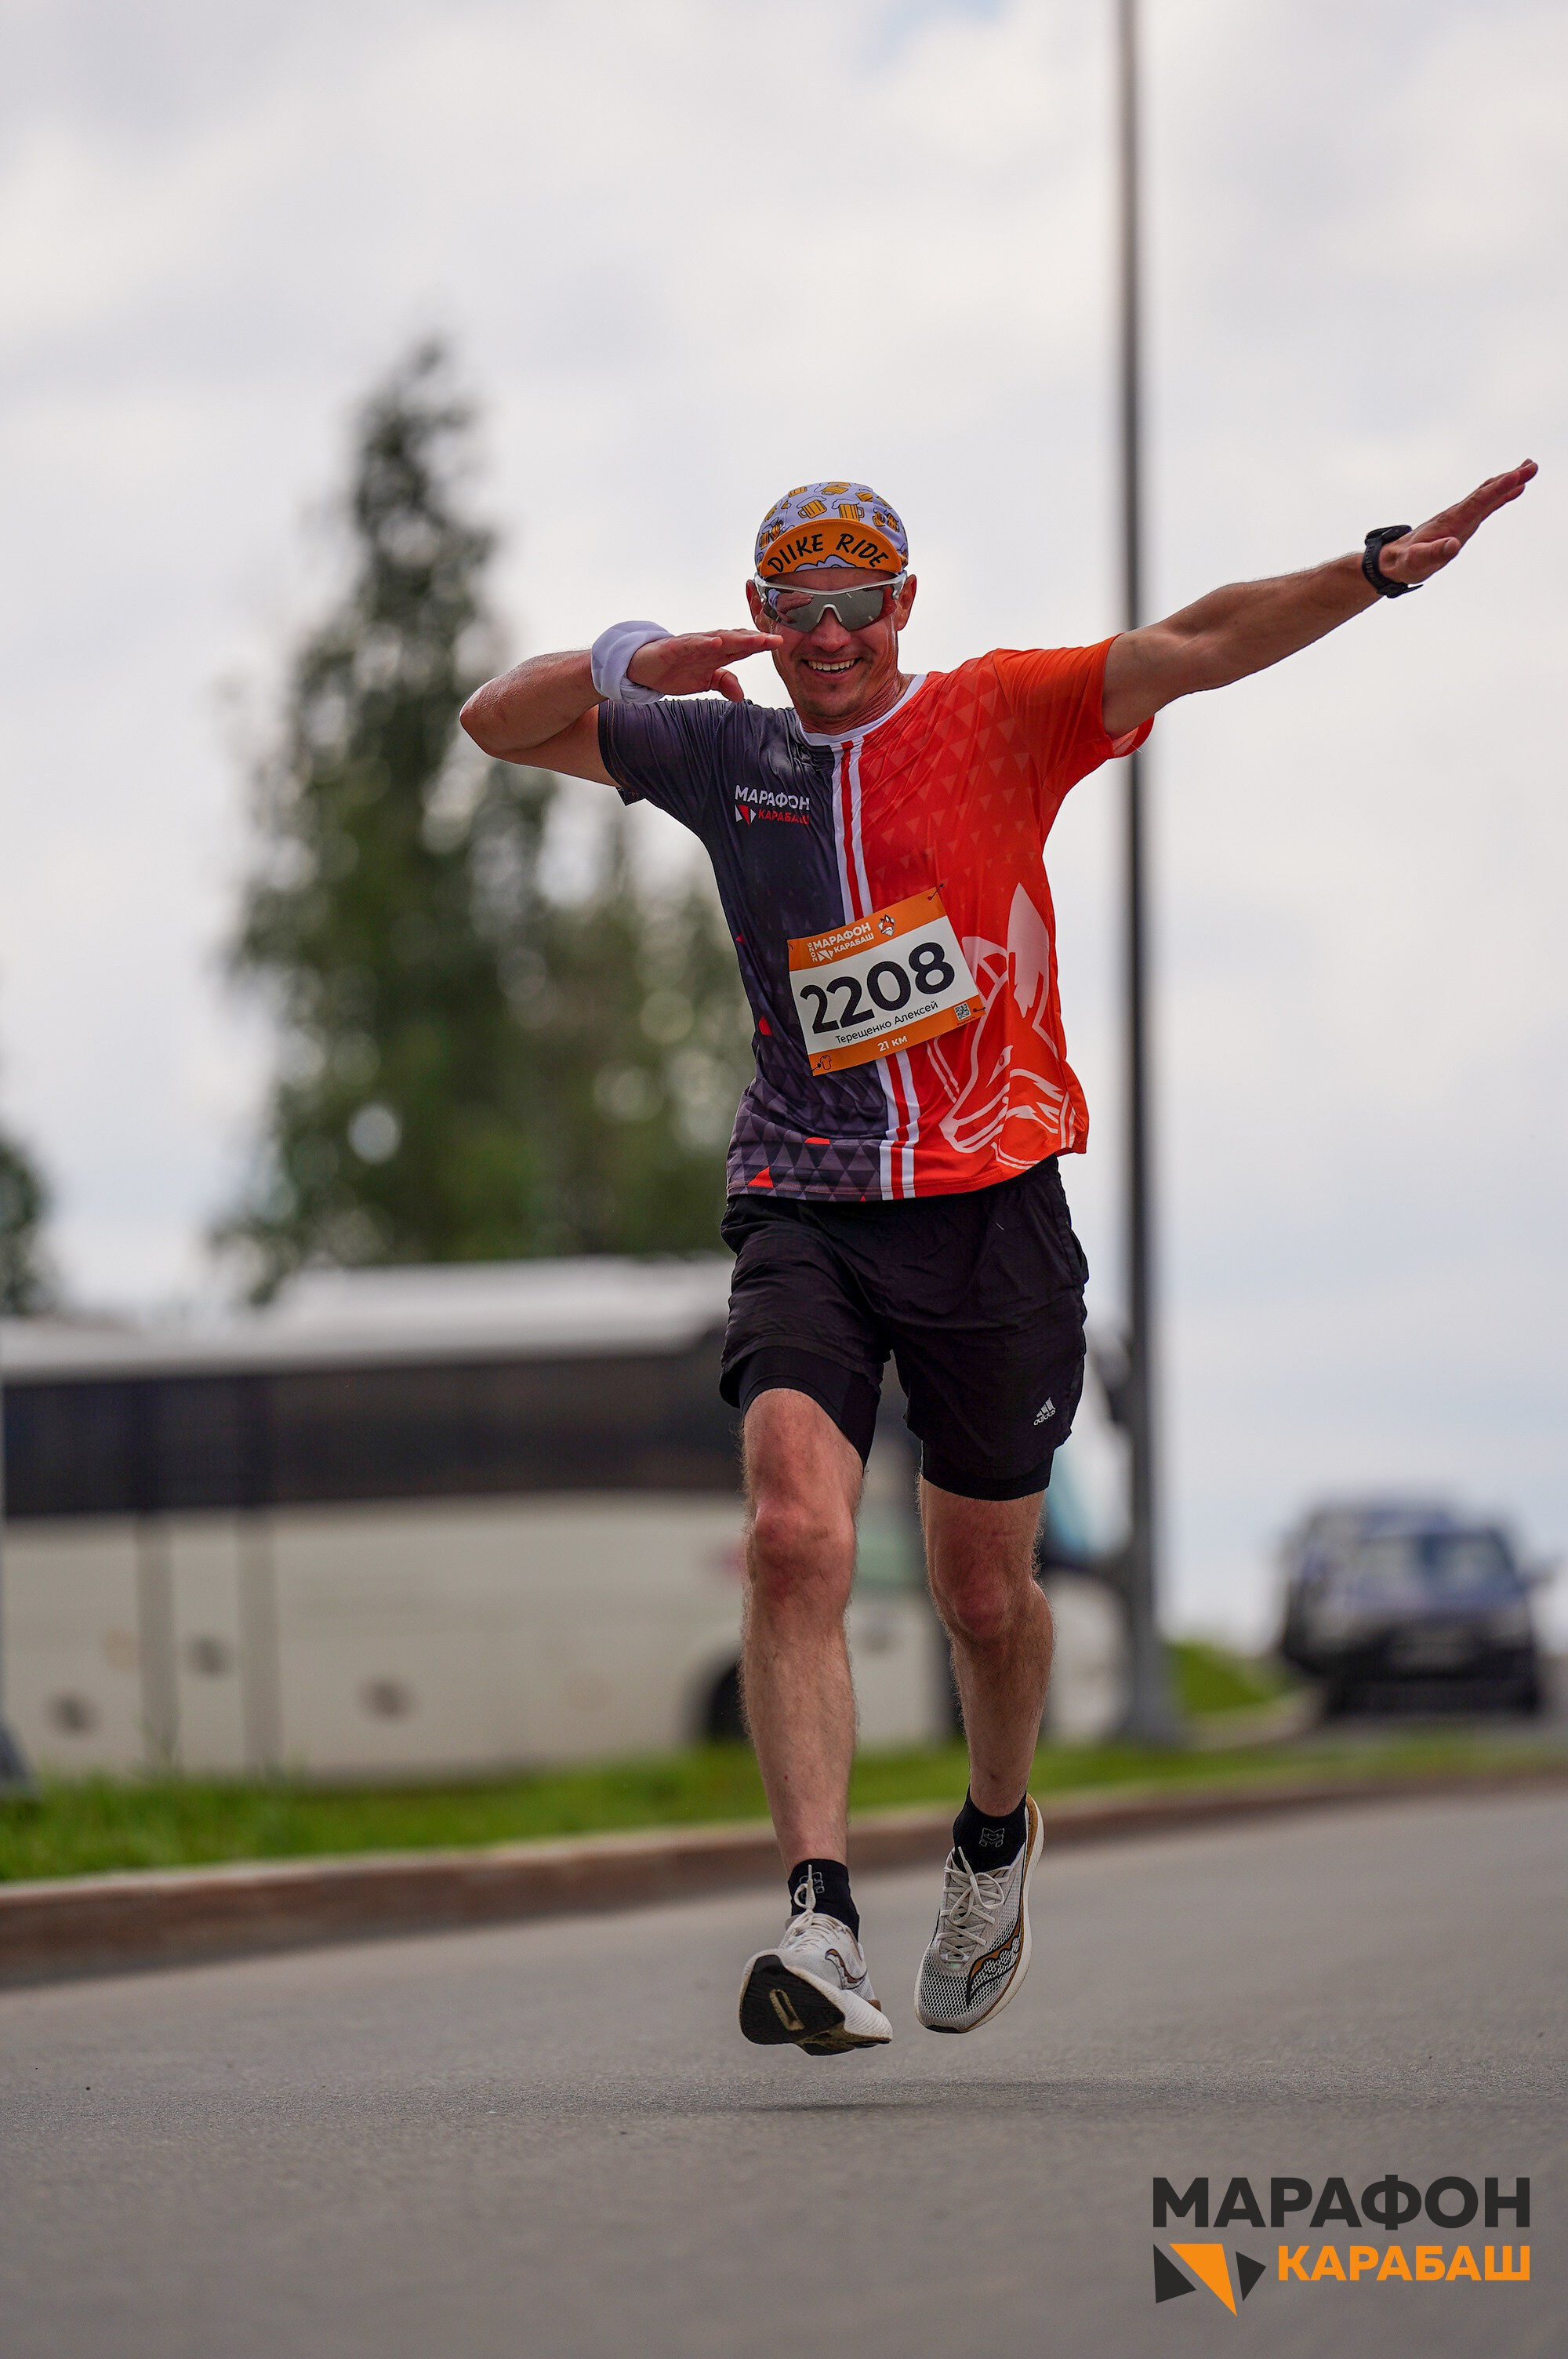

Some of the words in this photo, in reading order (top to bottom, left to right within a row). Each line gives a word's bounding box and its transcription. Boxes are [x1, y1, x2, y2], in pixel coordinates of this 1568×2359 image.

[836, 533, 889, 567] RIDE
[735, 784, 810, 810] МАРАФОН
[758, 809, 810, 825] КАРАБАШ
[812, 922, 872, 950] МАРАФОН
[833, 932, 874, 953] КАРАБАШ
[808, 942, 818, 962] 2026
[799, 942, 955, 1034] 2208
[835, 1020, 891, 1044] Терещенко
[894, 1000, 938, 1025] Алексей
[877, 1041, 890, 1052] 21
